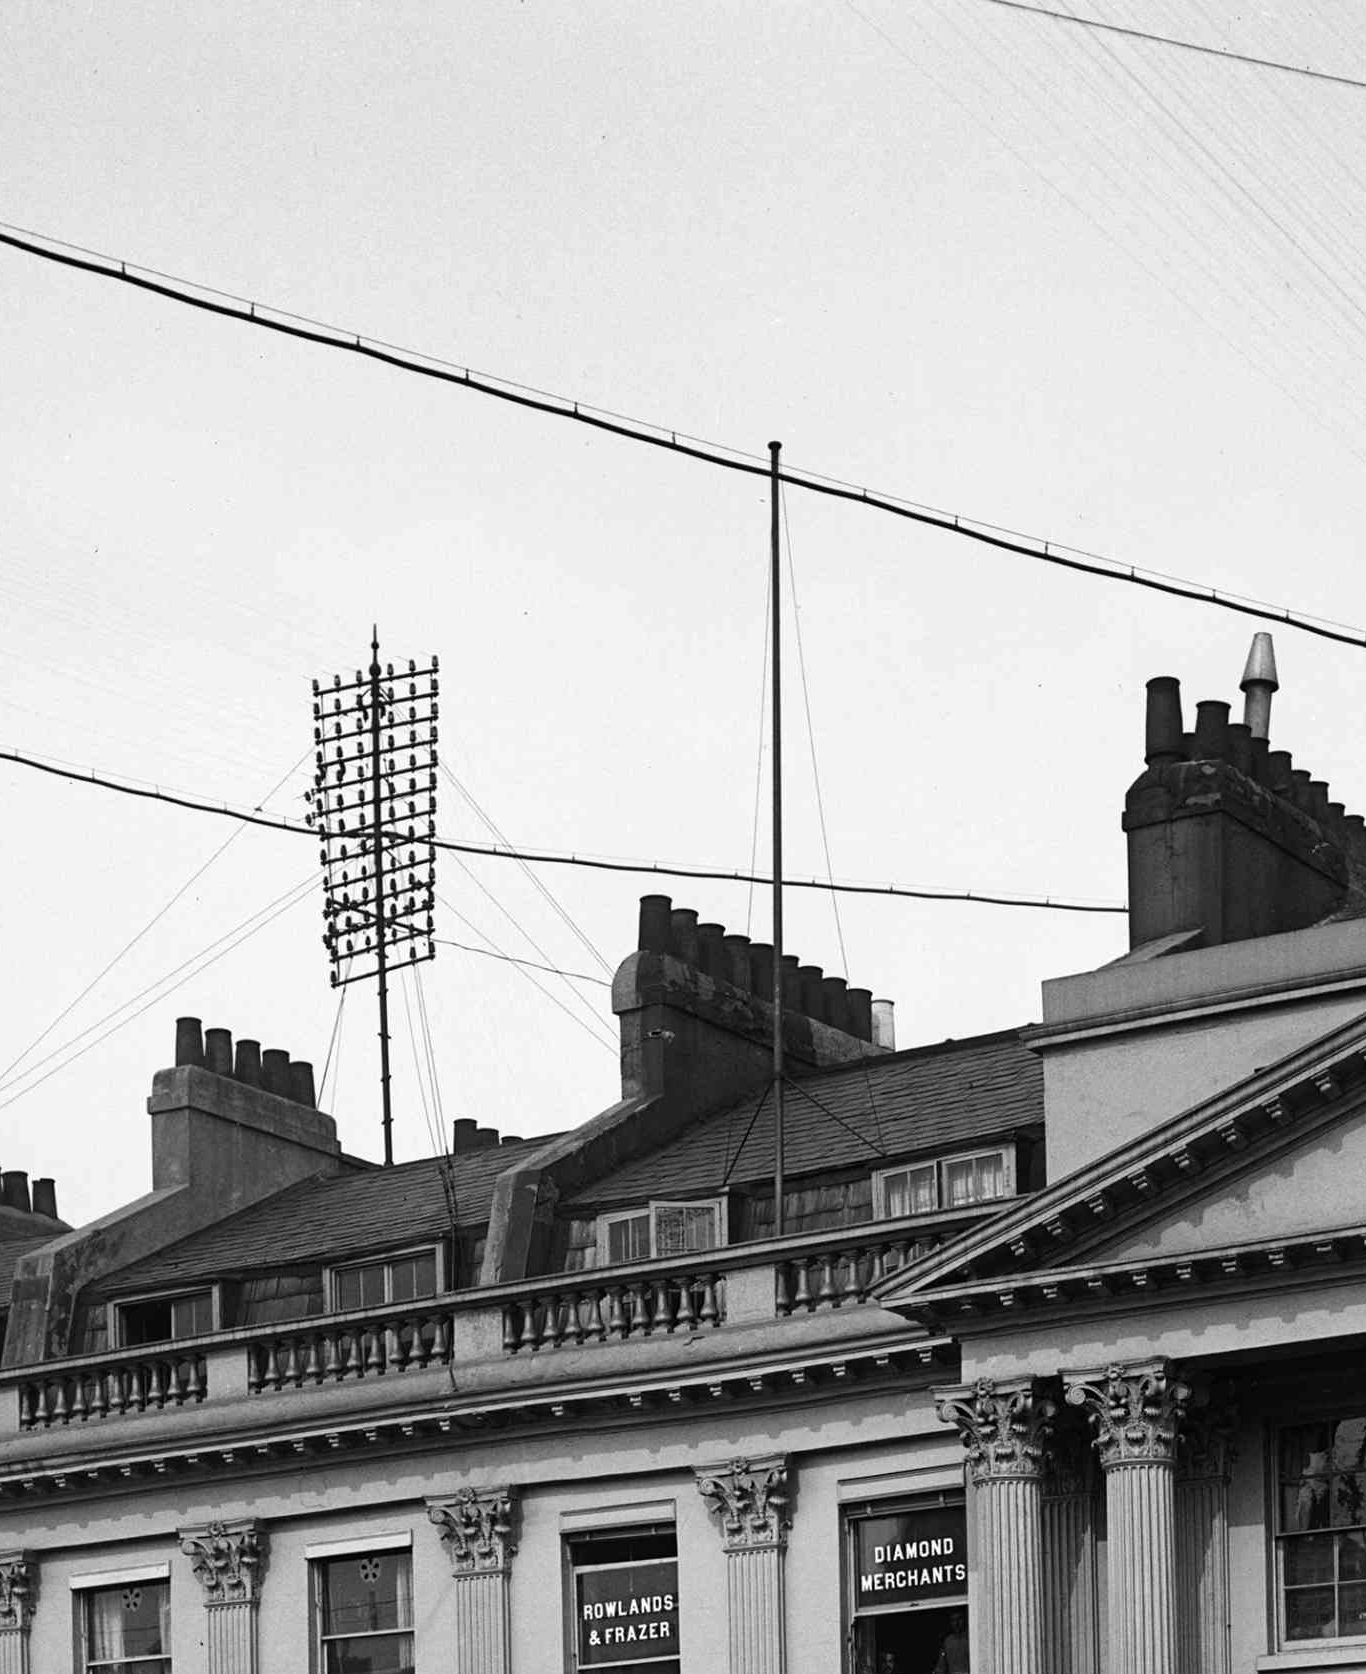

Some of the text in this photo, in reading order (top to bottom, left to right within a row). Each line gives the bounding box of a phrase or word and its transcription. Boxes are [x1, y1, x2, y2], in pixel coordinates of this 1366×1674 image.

[874, 1537, 954, 1565] DIAMOND
[861, 1564, 967, 1592] MERCHANTS
[583, 1594, 675, 1621] ROWLANDS
[589, 1621, 671, 1646] & FRAZER
